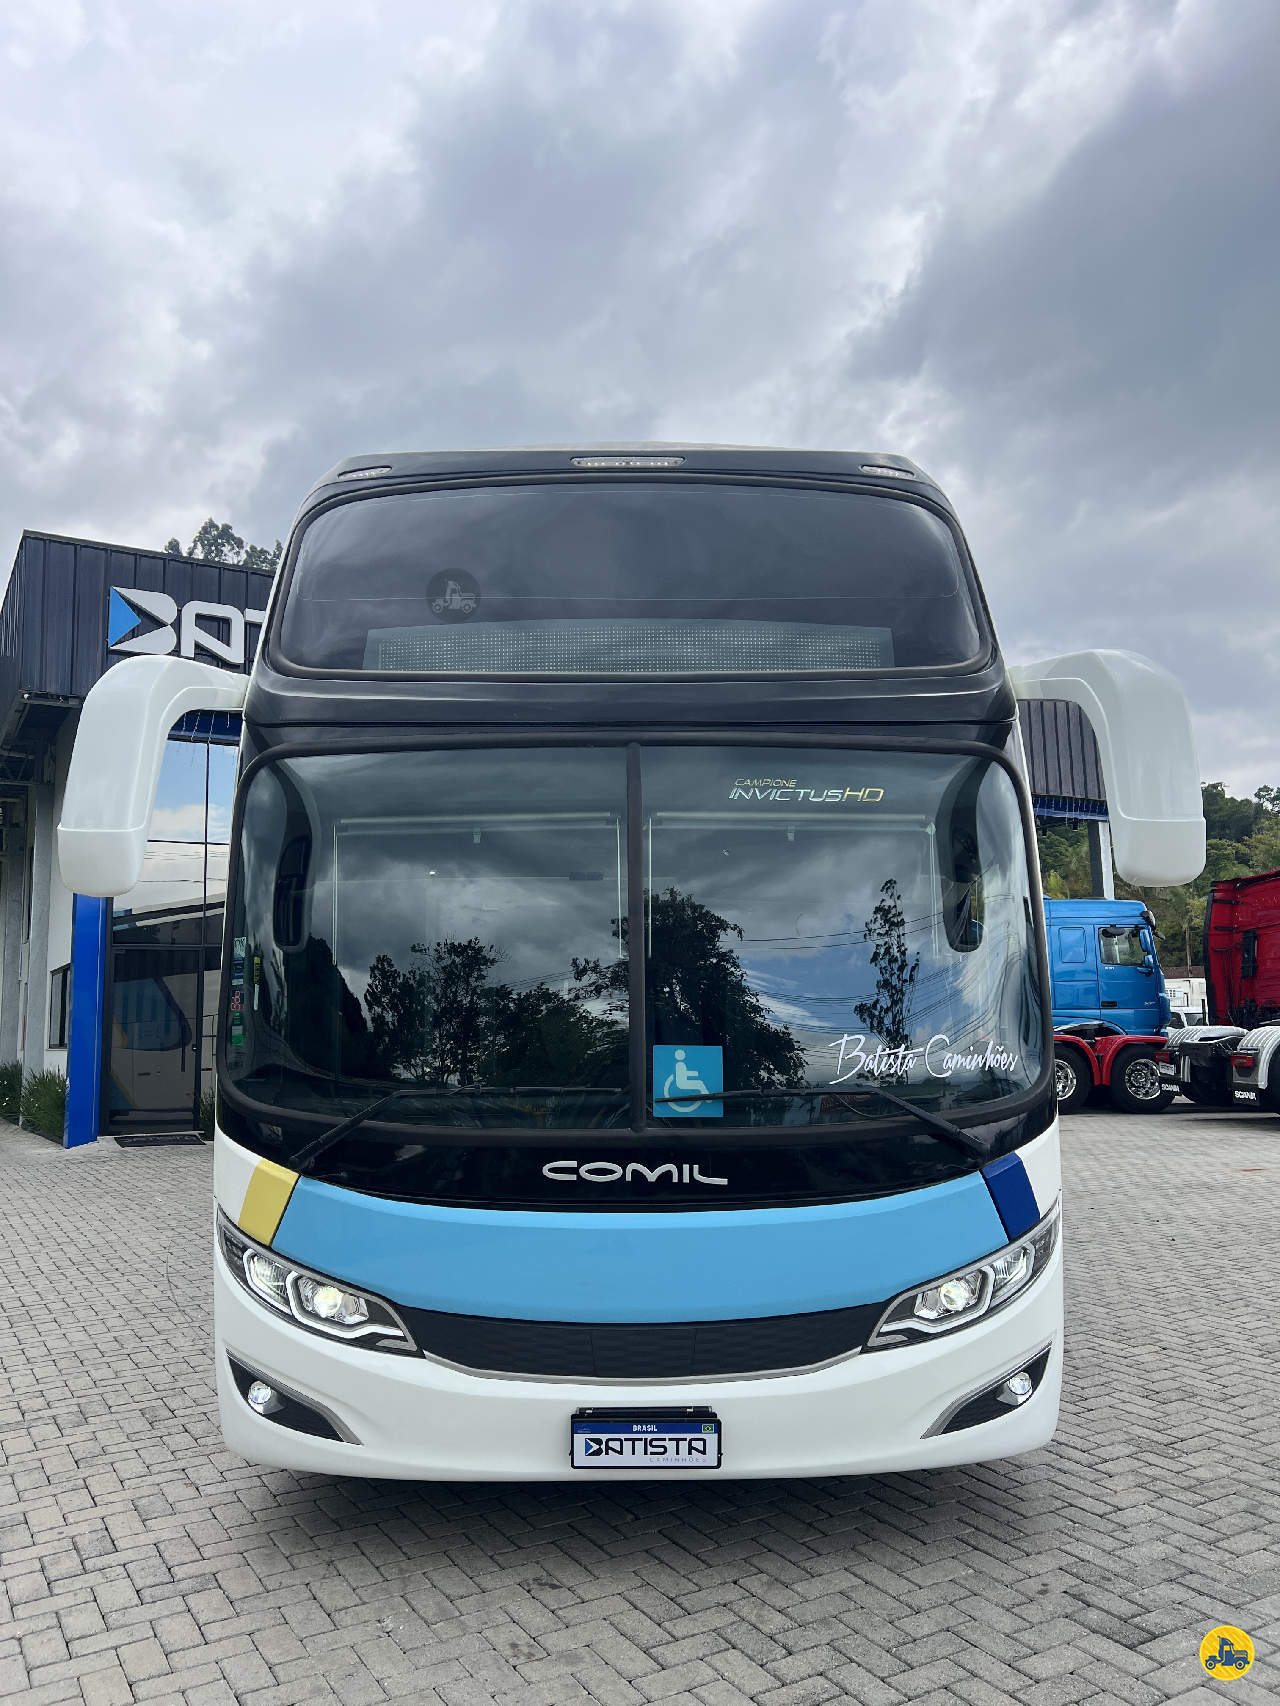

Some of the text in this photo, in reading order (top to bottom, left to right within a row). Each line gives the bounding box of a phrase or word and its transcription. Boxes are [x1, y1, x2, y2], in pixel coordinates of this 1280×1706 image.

[734, 778, 797, 787] CAMPIONE
[828, 1033, 1019, 1085] Batista Caminhões
[1161, 1083, 1180, 1092] SCANIA
[1234, 1090, 1257, 1101] SCANIA
[542, 1160, 729, 1186] COMIL
[632, 1424, 658, 1432] BRASIL
[585, 1437, 707, 1457] BATISTA
